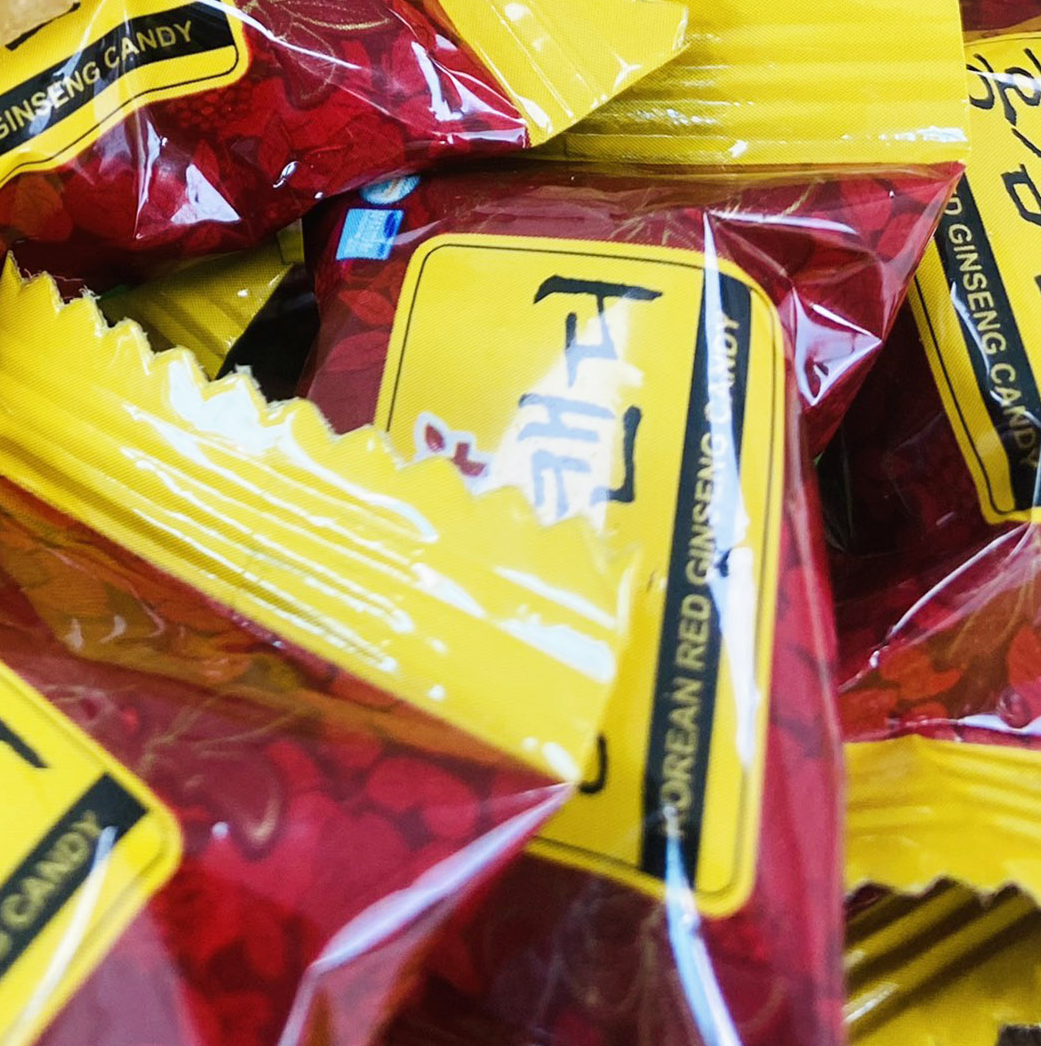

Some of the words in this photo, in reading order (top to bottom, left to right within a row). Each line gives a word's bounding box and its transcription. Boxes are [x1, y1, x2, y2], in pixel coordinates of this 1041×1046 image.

[104, 20, 194, 70] CANDY
[517, 274, 663, 519] 캔디
[948, 223, 1006, 355] GINSENG
[990, 362, 1038, 469] CANDY
[684, 432, 730, 586] GINSENG
[673, 592, 711, 671] RED
[0, 807, 103, 925] CANDY
